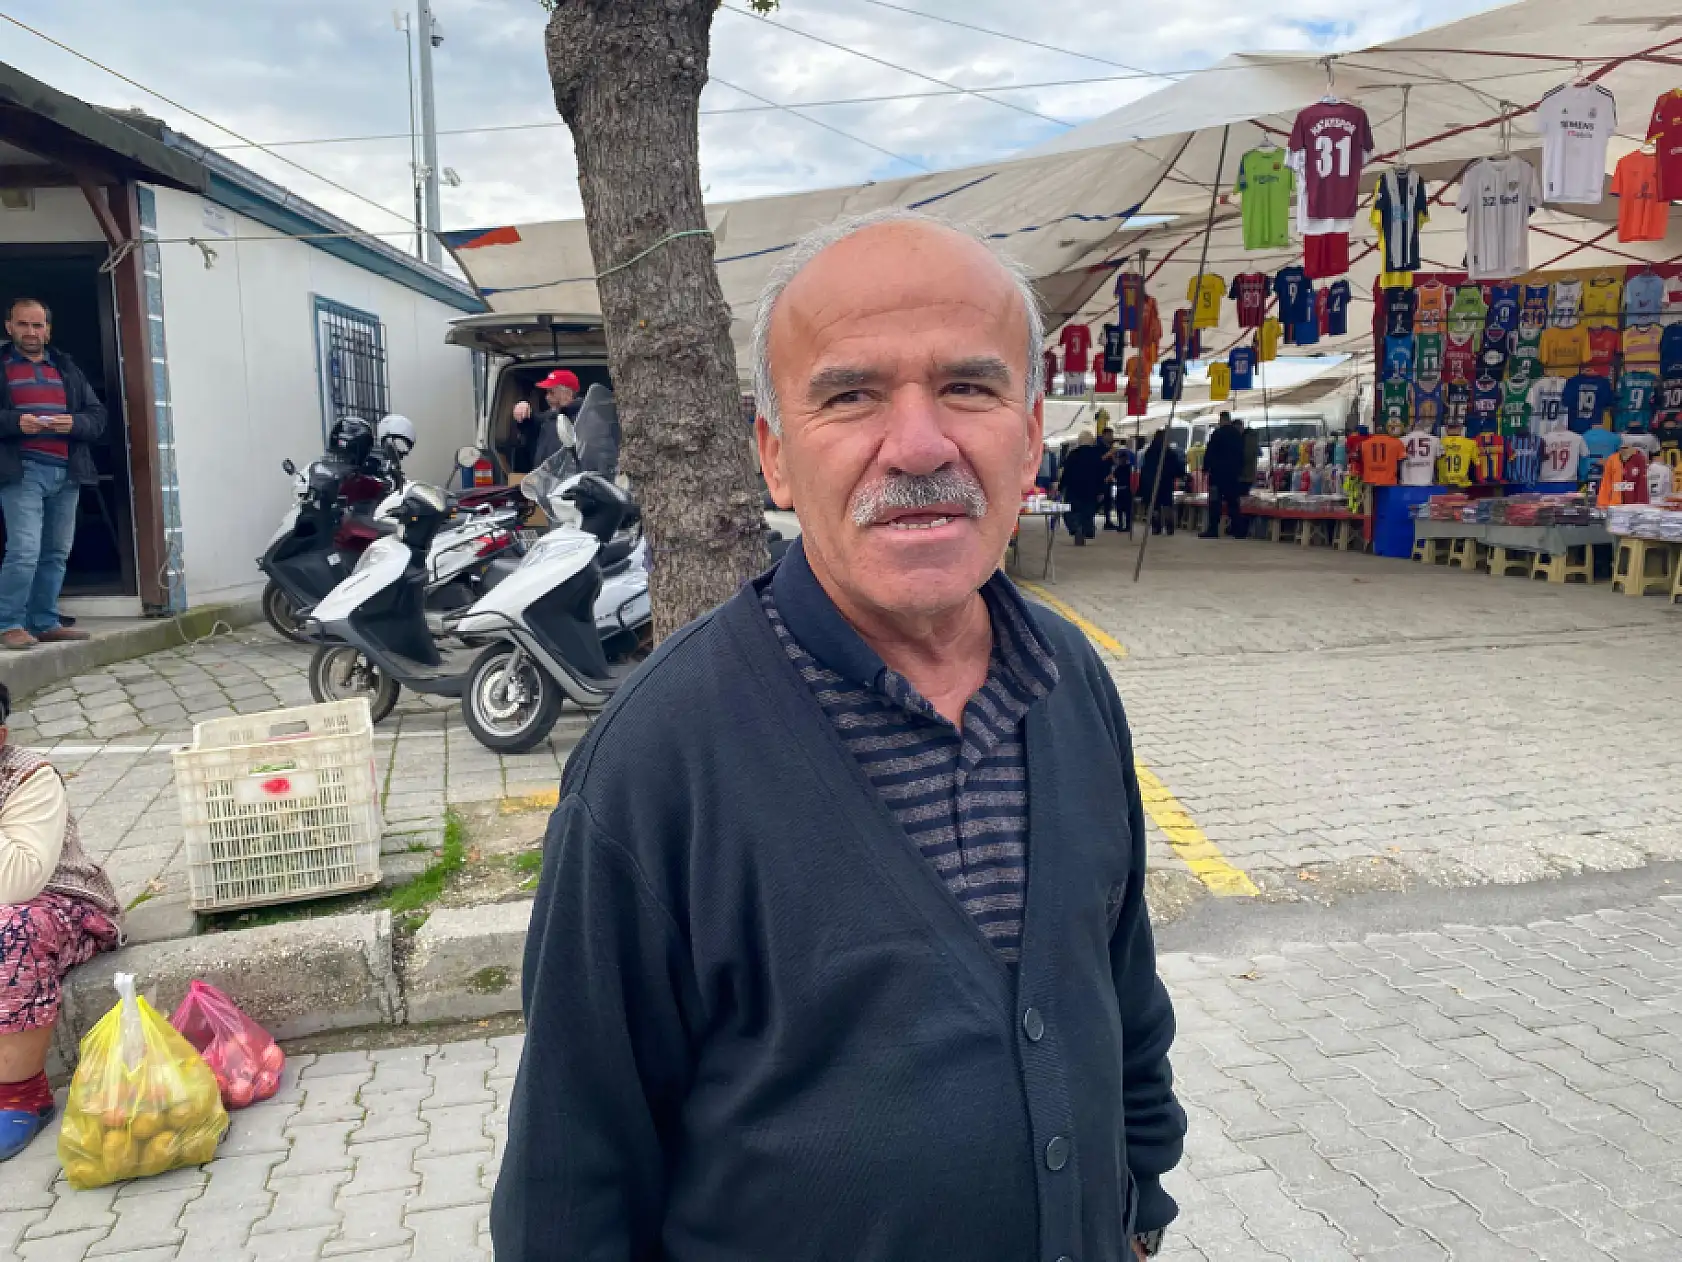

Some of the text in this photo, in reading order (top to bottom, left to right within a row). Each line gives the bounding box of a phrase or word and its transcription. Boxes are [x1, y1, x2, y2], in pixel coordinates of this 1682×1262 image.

[1315, 136, 1351, 178] 31
[1371, 443, 1387, 463] 11
[1407, 438, 1431, 458] 45
